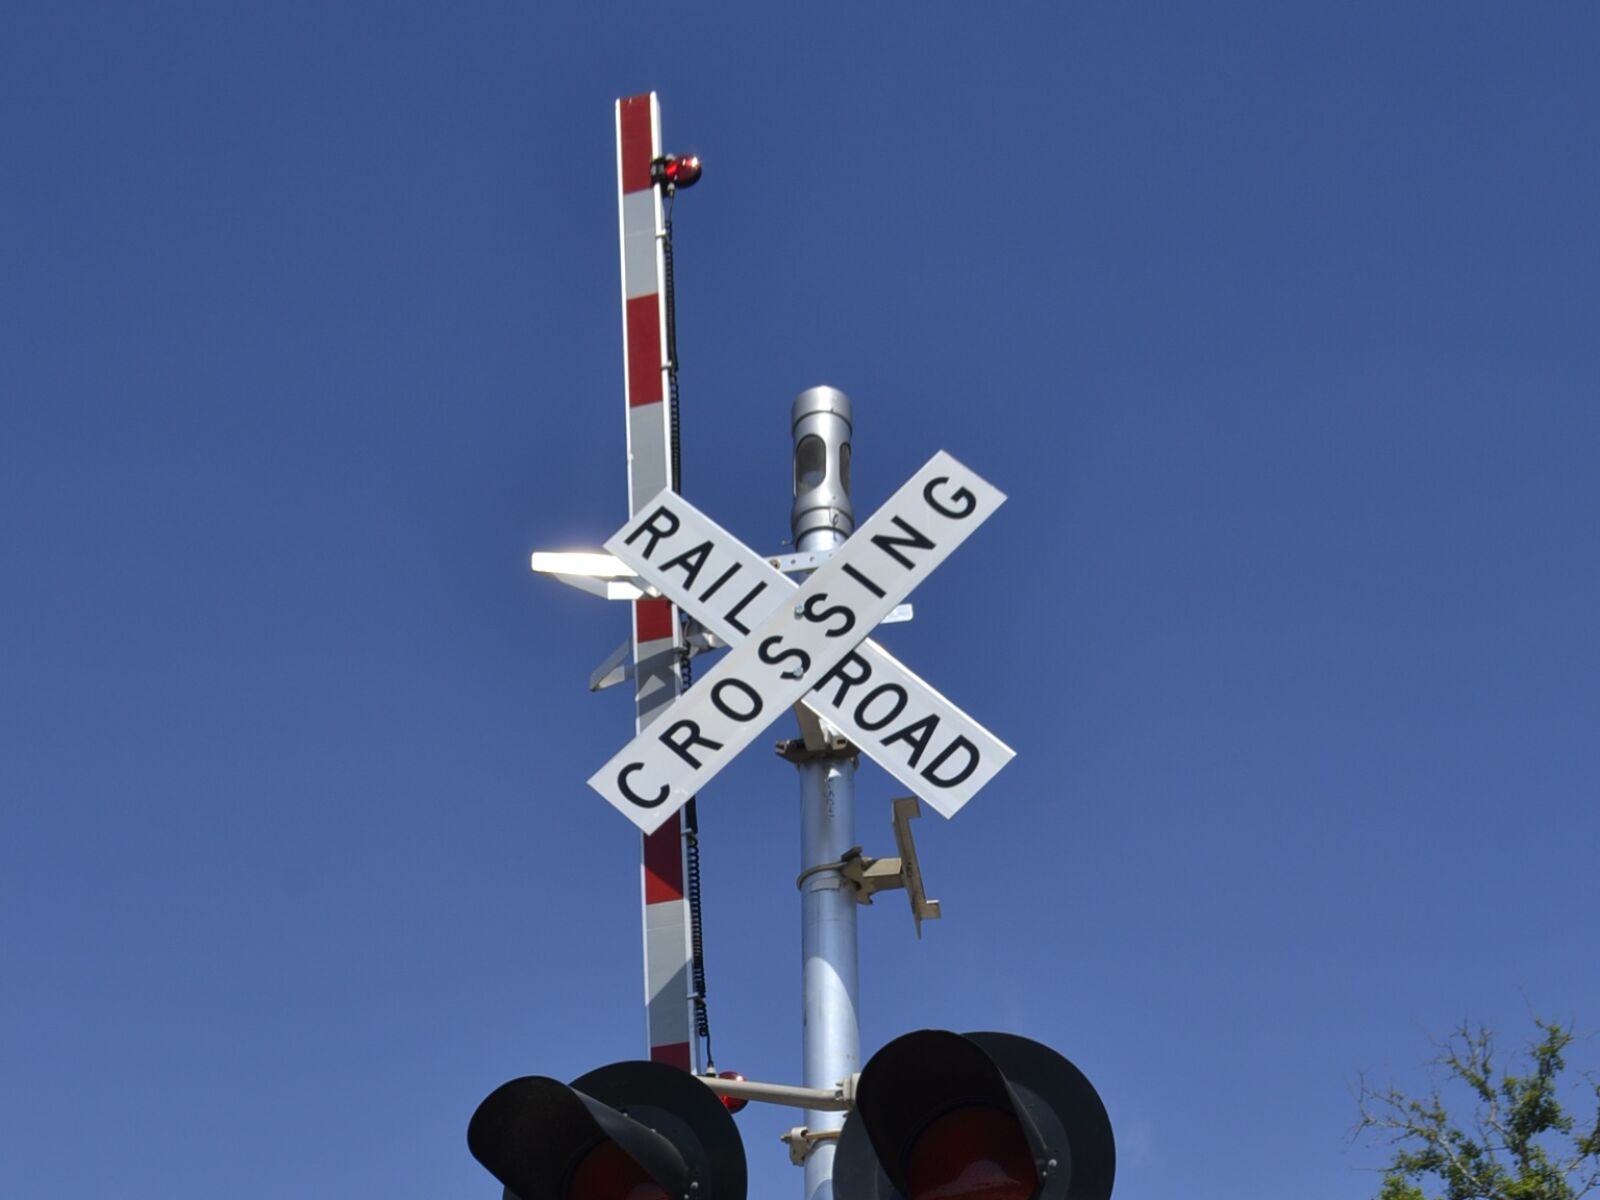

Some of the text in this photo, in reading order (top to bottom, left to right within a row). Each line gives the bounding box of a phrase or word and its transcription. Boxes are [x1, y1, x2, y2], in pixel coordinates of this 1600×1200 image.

[617, 476, 977, 809] CROSSING
[624, 506, 980, 789] RAIL ROAD
